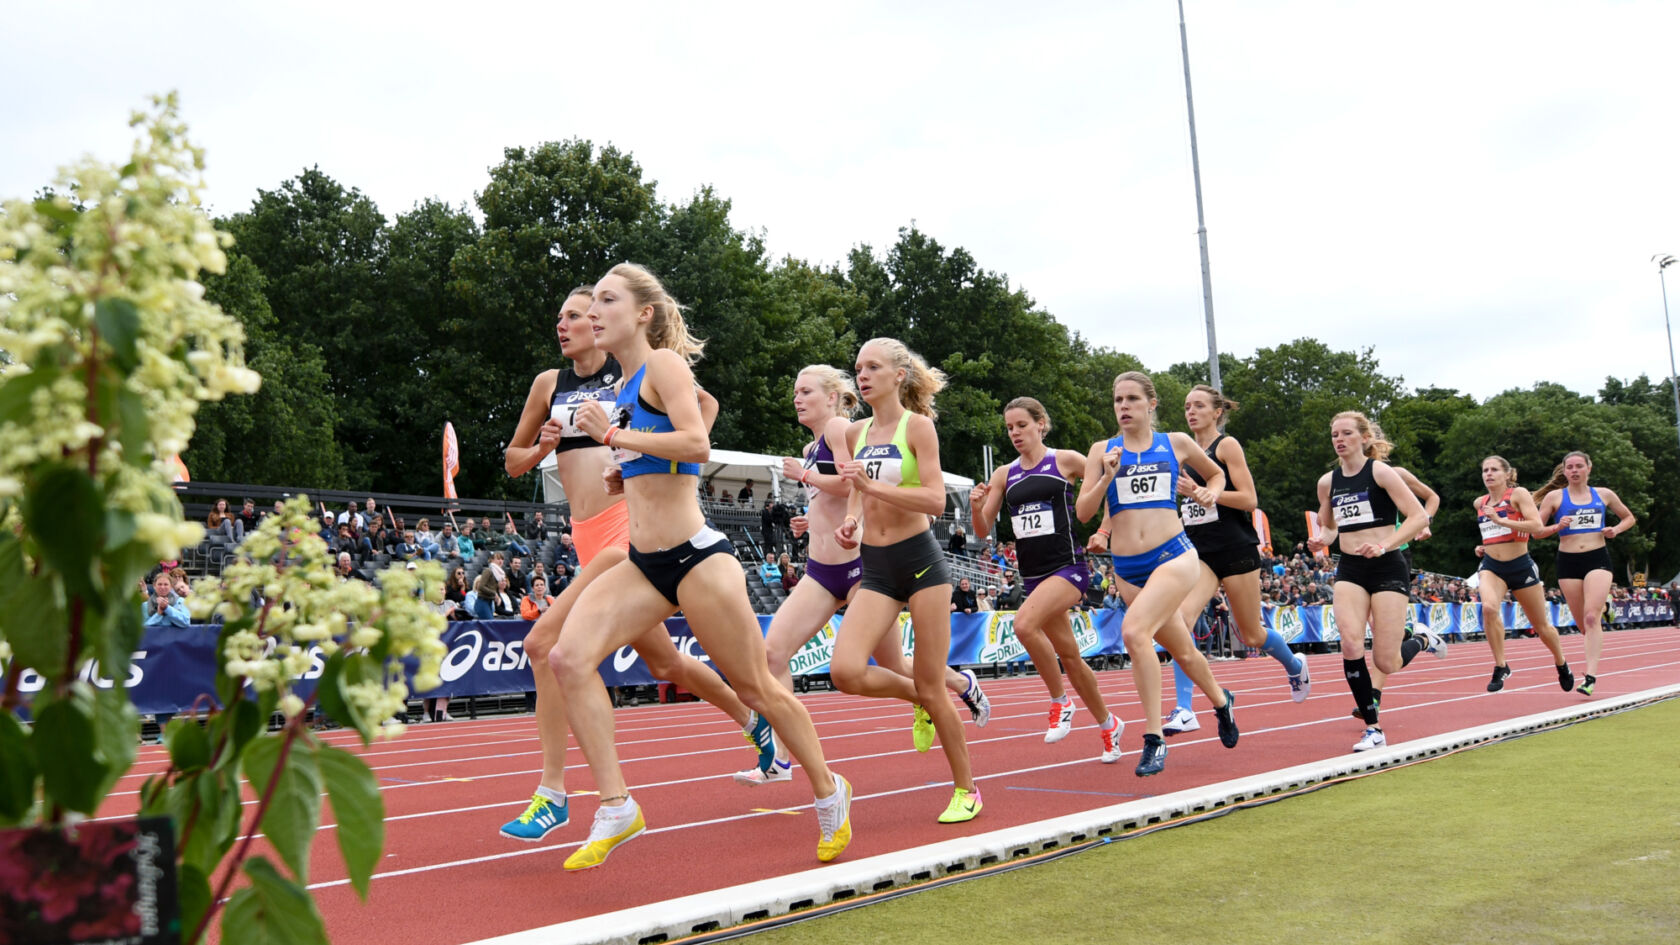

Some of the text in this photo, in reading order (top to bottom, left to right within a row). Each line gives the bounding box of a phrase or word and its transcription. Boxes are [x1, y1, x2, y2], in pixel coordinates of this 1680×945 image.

[872, 446, 890, 456] asics
[1137, 464, 1159, 473] asics
[1130, 475, 1158, 495] 667
[1024, 503, 1042, 512] asics
[1340, 504, 1361, 519] 352
[1020, 514, 1042, 531] 712
[1577, 515, 1595, 525] 254
[788, 644, 832, 674] DRINK
